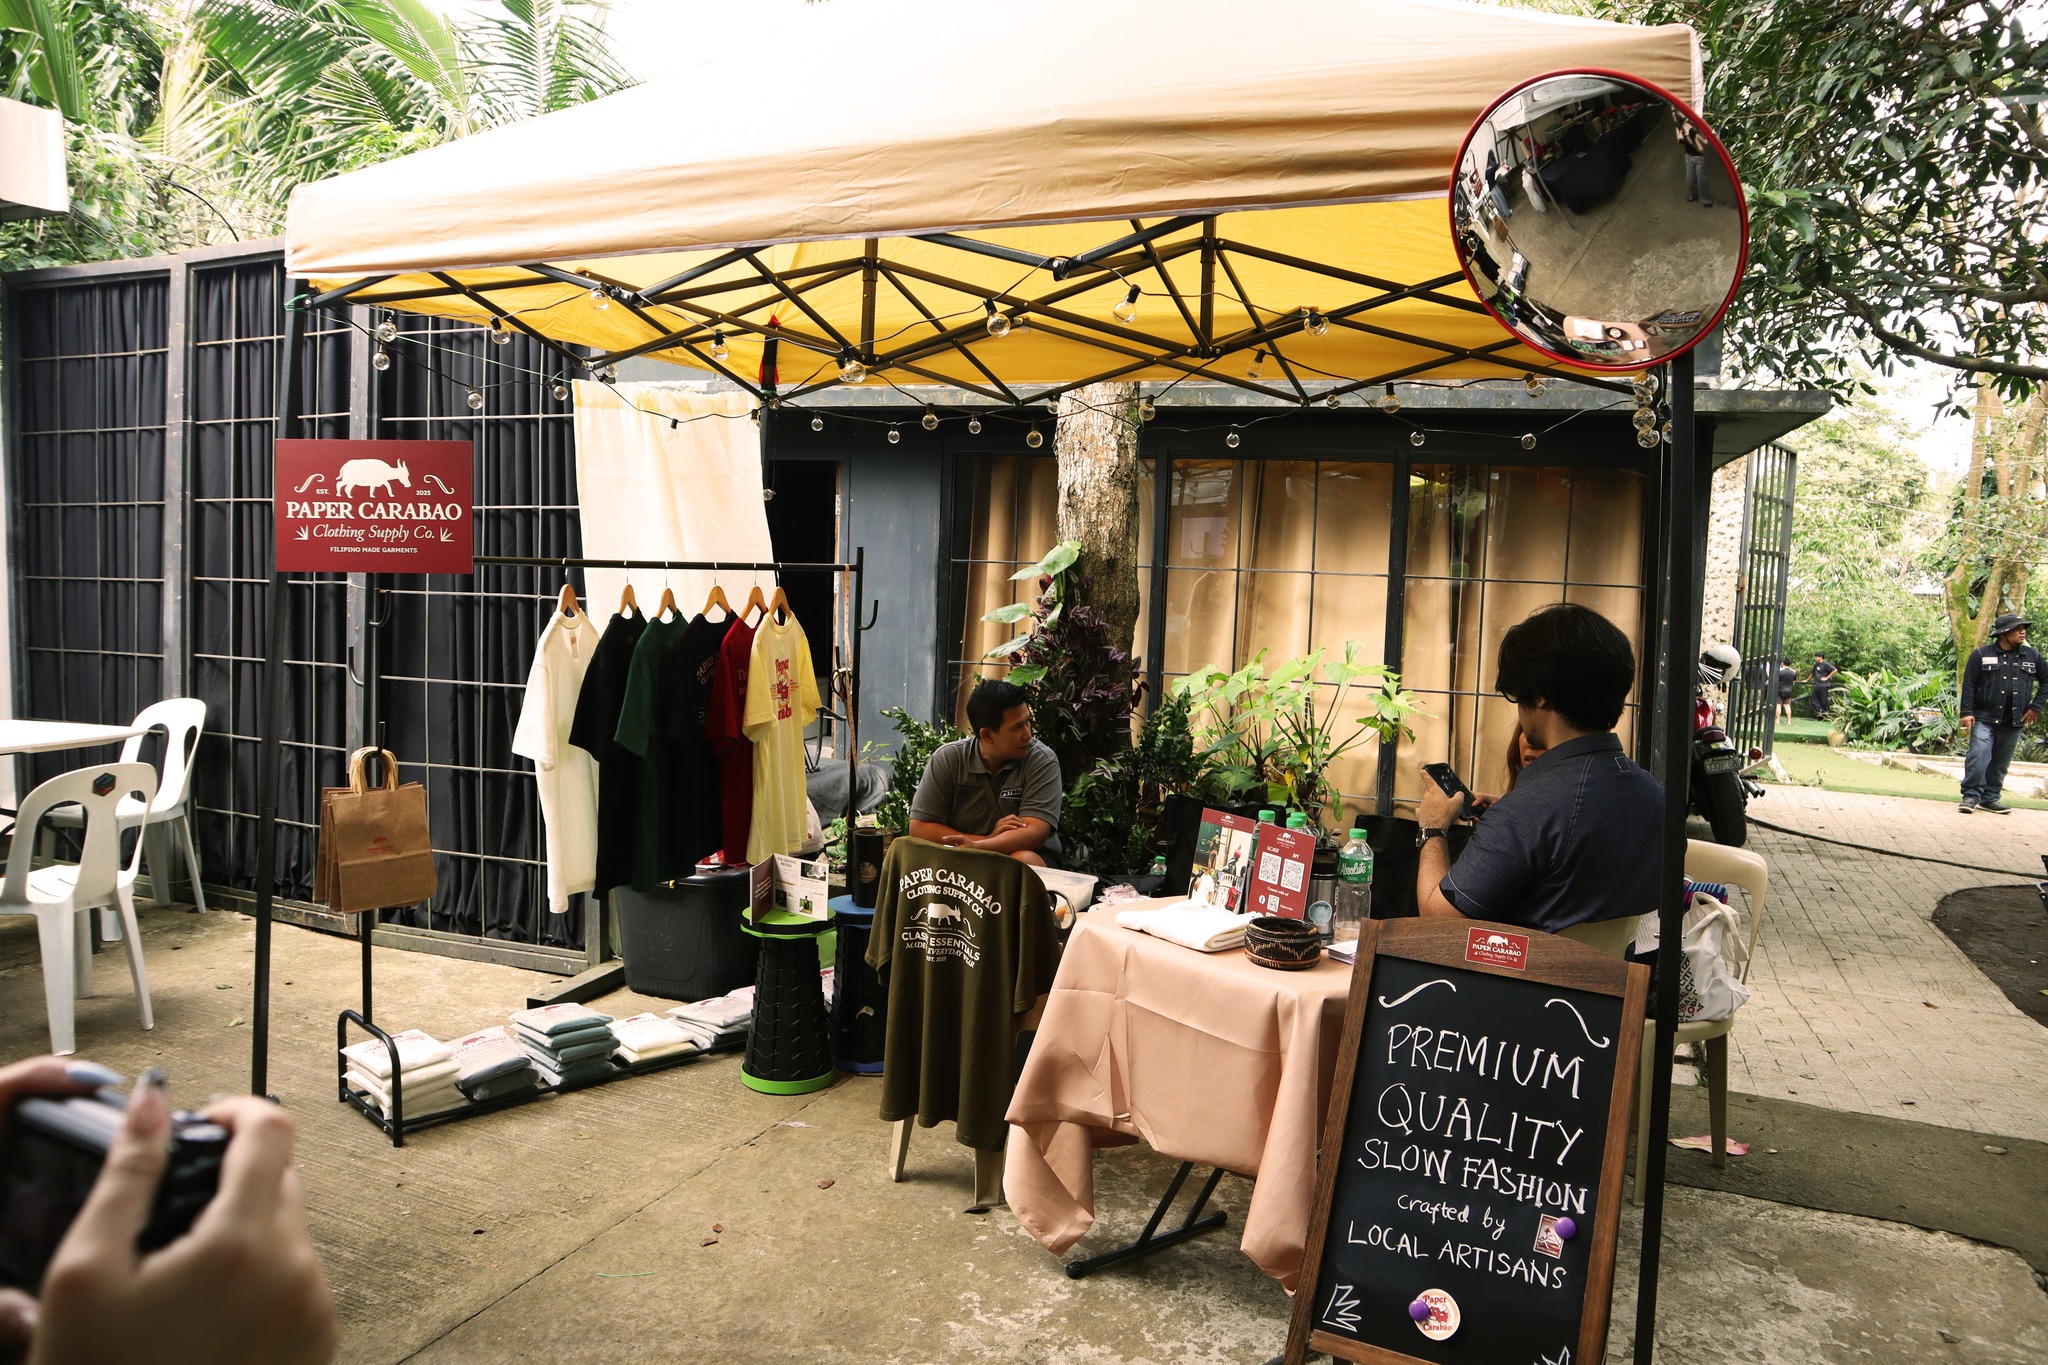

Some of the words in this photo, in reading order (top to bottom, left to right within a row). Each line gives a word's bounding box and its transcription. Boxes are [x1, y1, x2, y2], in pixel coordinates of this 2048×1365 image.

[286, 501, 355, 519] PAPER
[358, 502, 462, 521] CARABAO
[313, 524, 366, 542] Clothing
[368, 525, 409, 543] Supply
[413, 525, 435, 539] Co.
[1341, 862, 1367, 876] Absolute
[900, 868, 933, 892] PAPER
[935, 869, 1002, 915] CARABAO
[942, 886, 973, 906] SUPPLY
[971, 903, 984, 918] CO.
[905, 941, 927, 949] MADE
[929, 937, 981, 961] ESSENTIALS
[1492, 947, 1521, 956] CARABAO
[1387, 1023, 1585, 1100] PREMIUM
[1377, 1082, 1584, 1166] QUALITY
[1357, 1138, 1452, 1184] SLOW
[1460, 1156, 1589, 1215] FASHION
[1397, 1194, 1470, 1225] crafted
[1482, 1206, 1506, 1241] by
[1347, 1219, 1429, 1259] LOCAL
[1438, 1239, 1567, 1289] ARTISANS
[1422, 1294, 1448, 1305] Paper
[1422, 1323, 1452, 1331] Carabao
